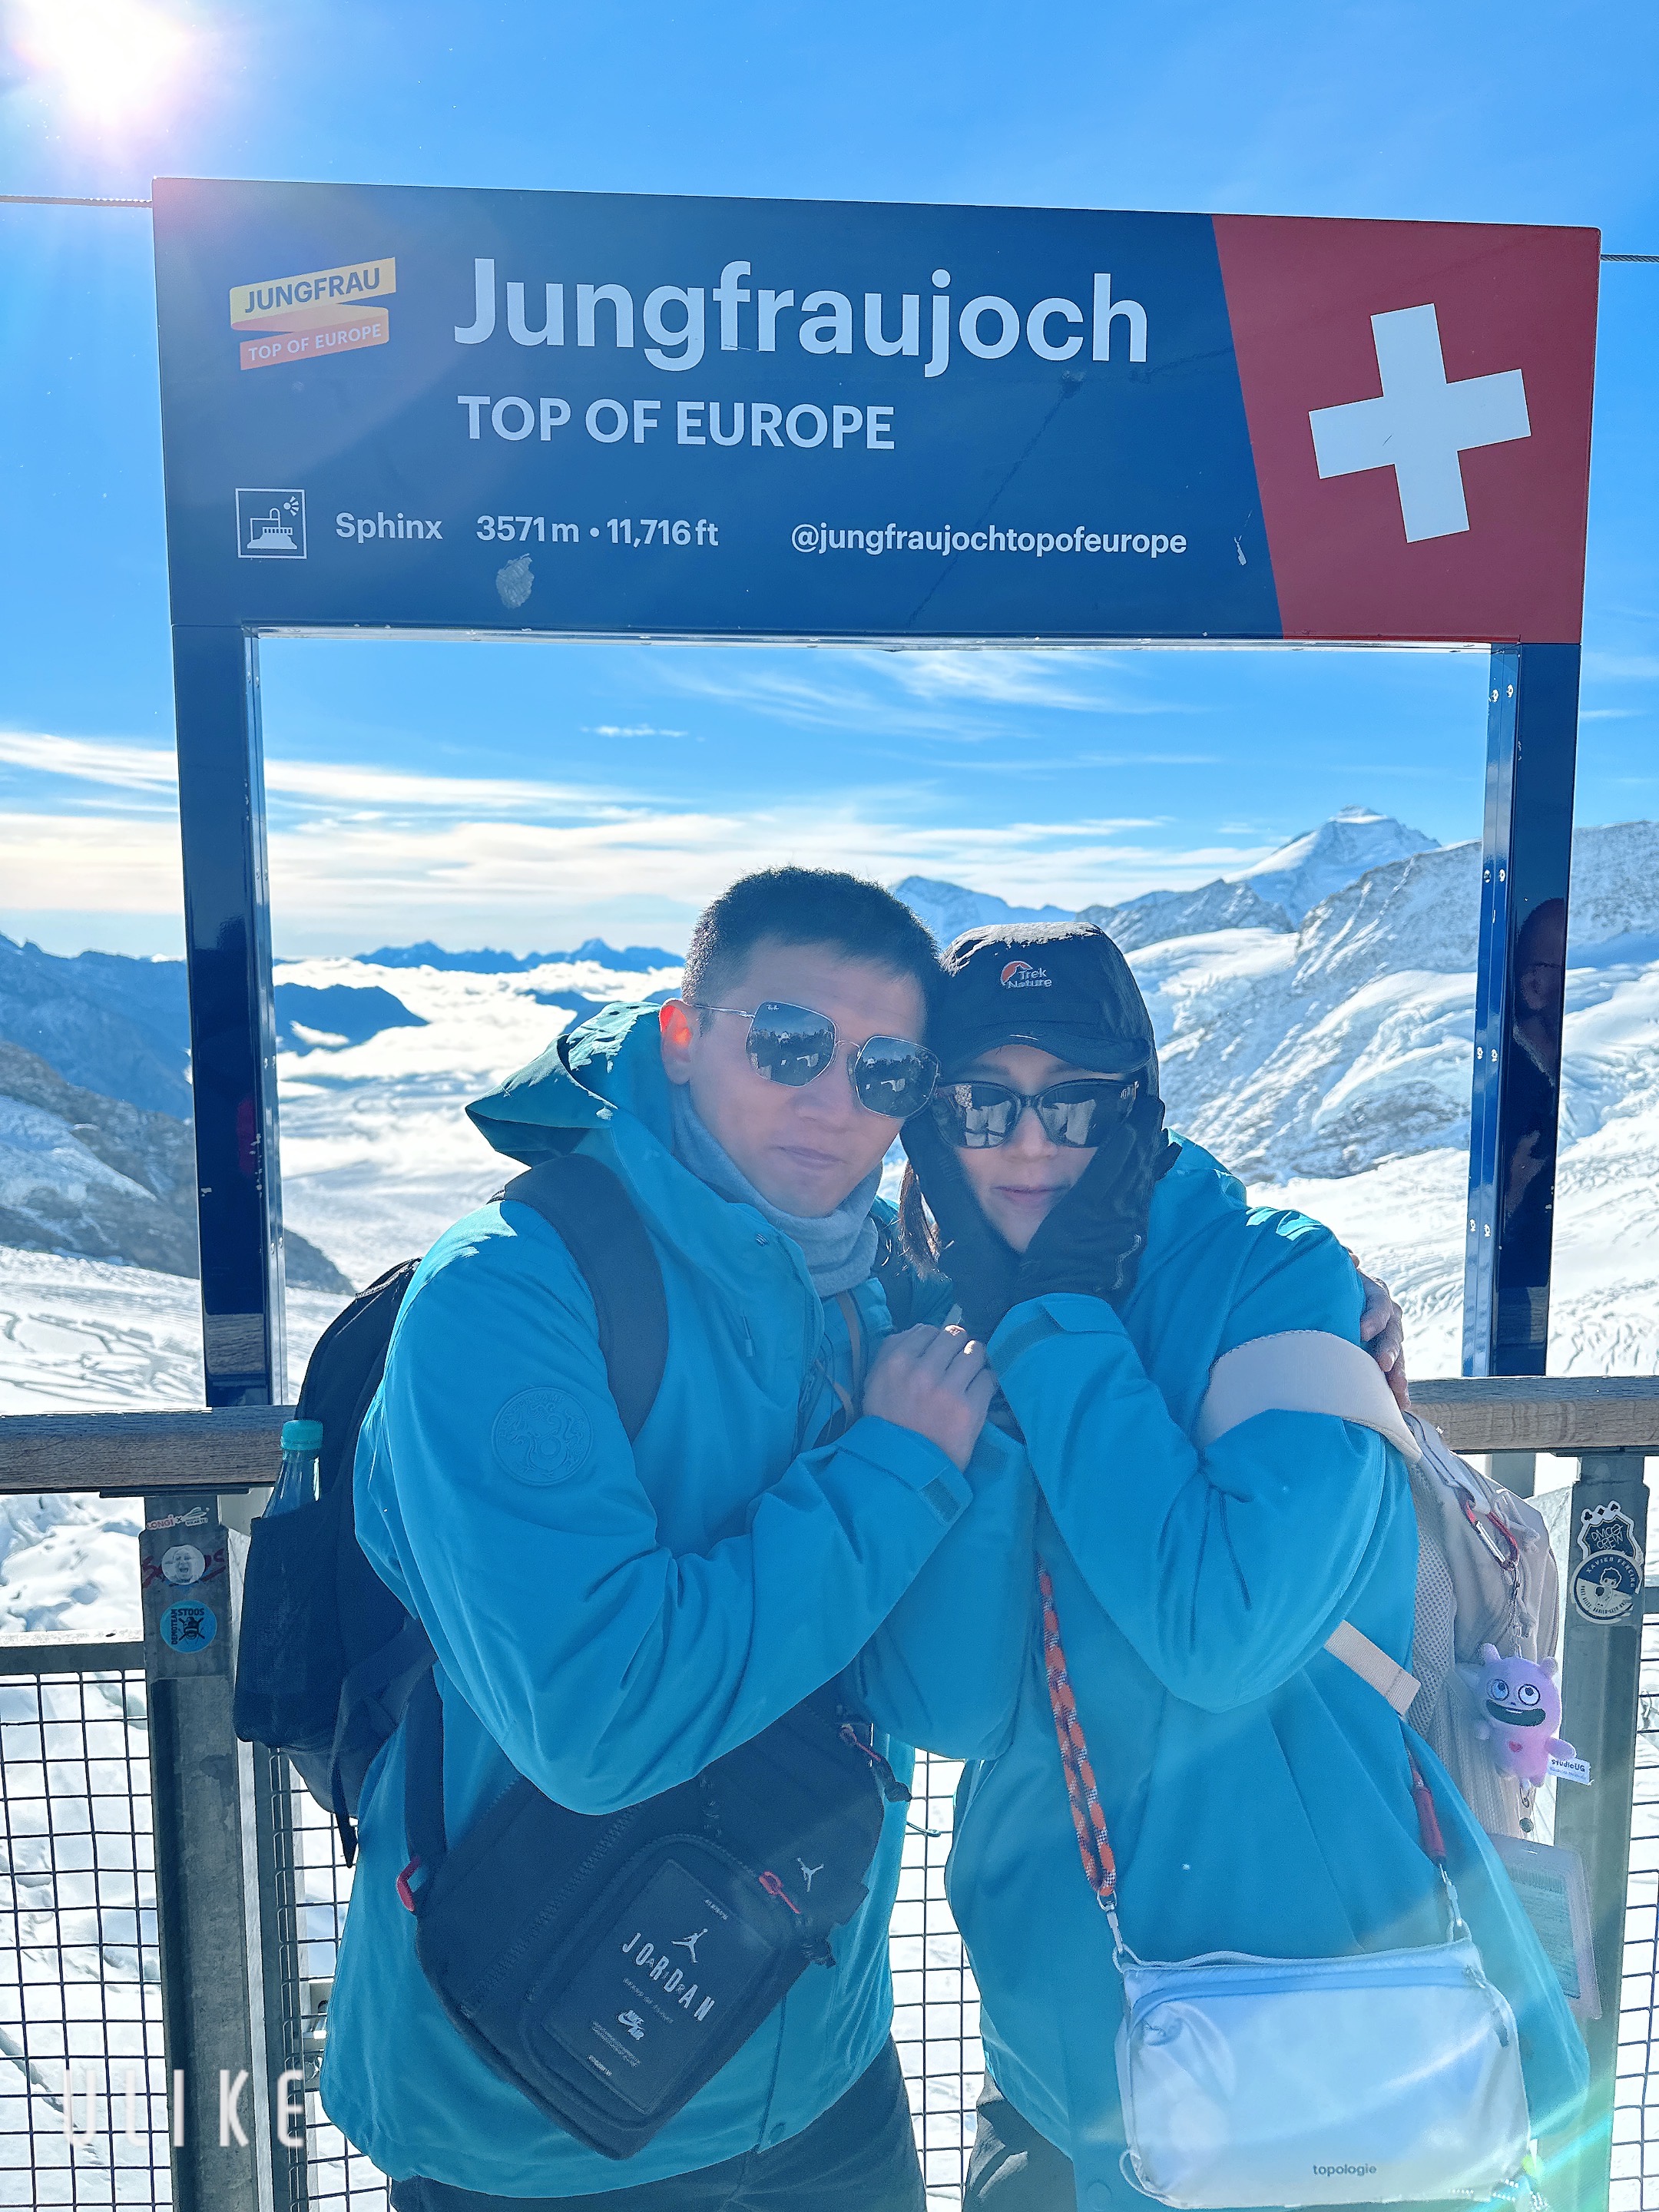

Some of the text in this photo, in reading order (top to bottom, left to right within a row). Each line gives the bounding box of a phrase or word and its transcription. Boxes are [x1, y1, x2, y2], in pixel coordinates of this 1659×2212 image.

[244, 267, 380, 313] JUNGFRAU
[454, 258, 1147, 377] Jungfraujoch
[248, 323, 382, 361] TOP OF EUROPE
[457, 395, 895, 450] TOP OF EUROPE
[336, 512, 443, 544] Sphinx
[791, 522, 1187, 558] @jungfraujochtopofeurope
[1006, 979, 1052, 989] Nature
[1018, 967, 1048, 980] Trek
[177, 1608, 205, 1616] STOOS
[622, 1932, 716, 2022] JORDAN
[1313, 2163, 1377, 2177] topologie
